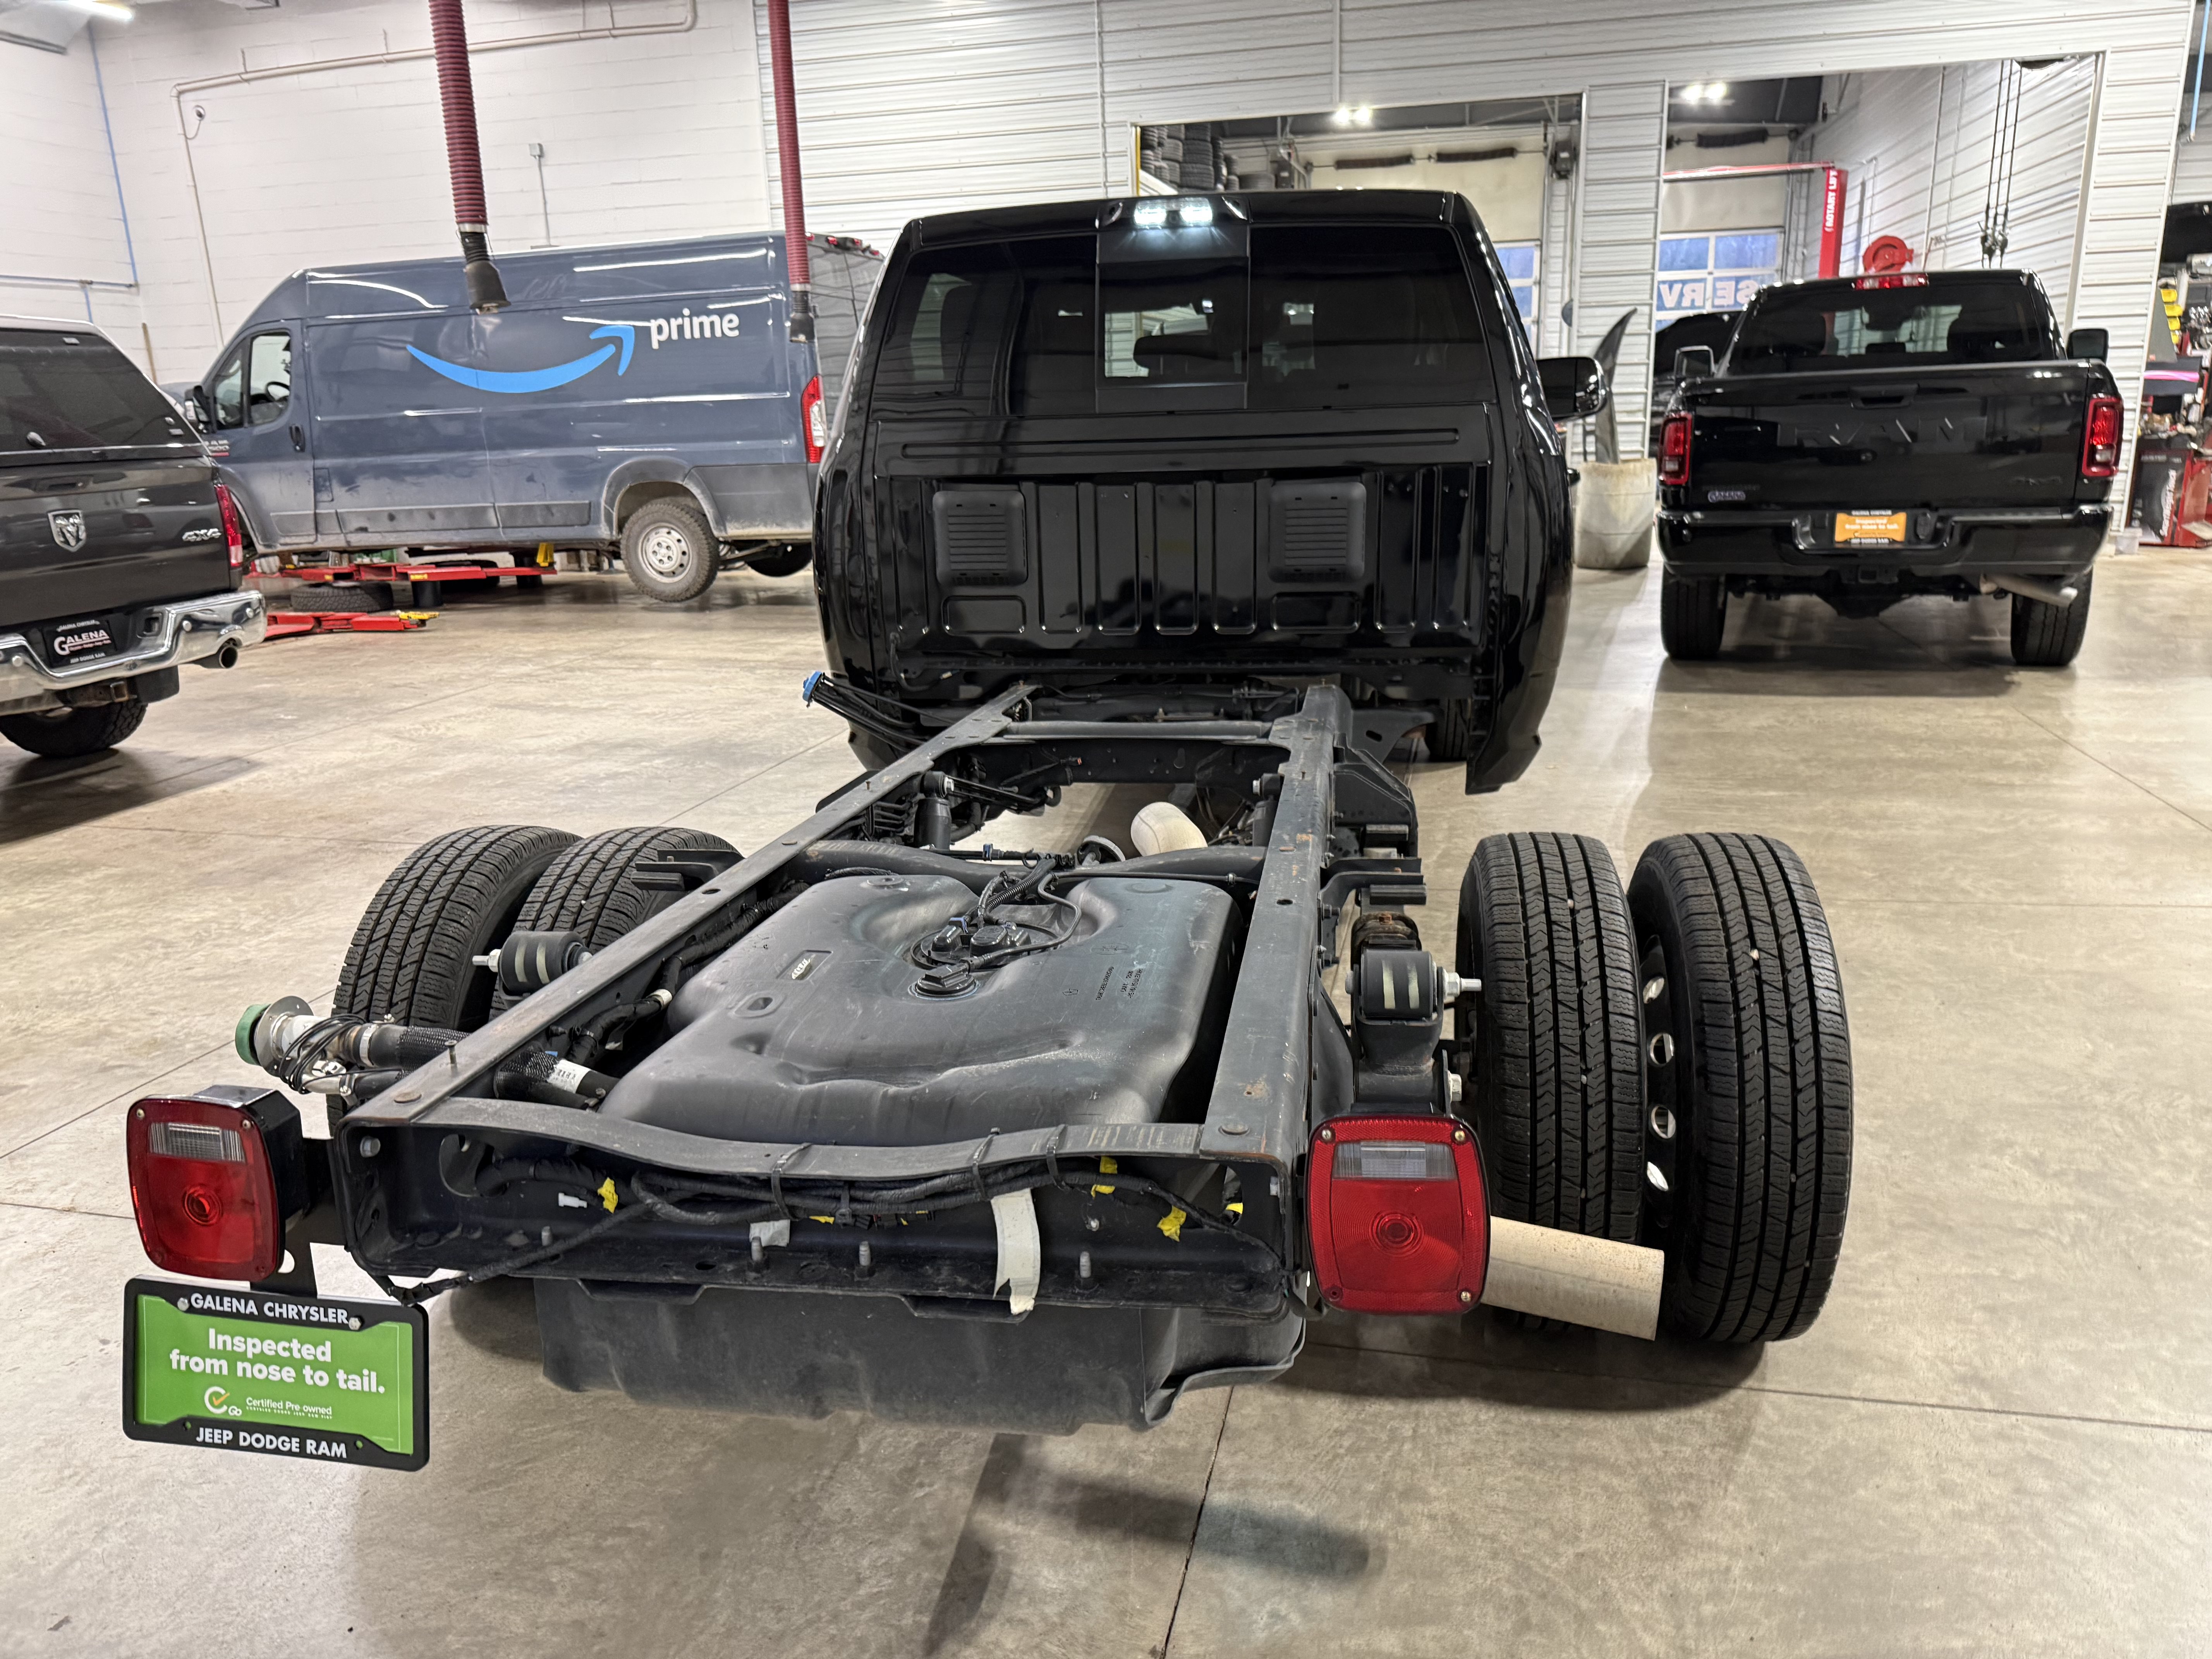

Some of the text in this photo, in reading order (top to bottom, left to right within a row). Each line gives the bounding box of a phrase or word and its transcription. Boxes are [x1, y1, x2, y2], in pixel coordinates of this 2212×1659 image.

[650, 308, 739, 349] prime
[54, 630, 110, 655] GALENA
[191, 1293, 349, 1324] GALENA CHRYSLER
[208, 1328, 331, 1362] Inspected
[170, 1349, 385, 1394] from nose to tail.
[246, 1397, 332, 1415] Certified Pre owned
[196, 1427, 347, 1459] JEEP DODGE RAM
